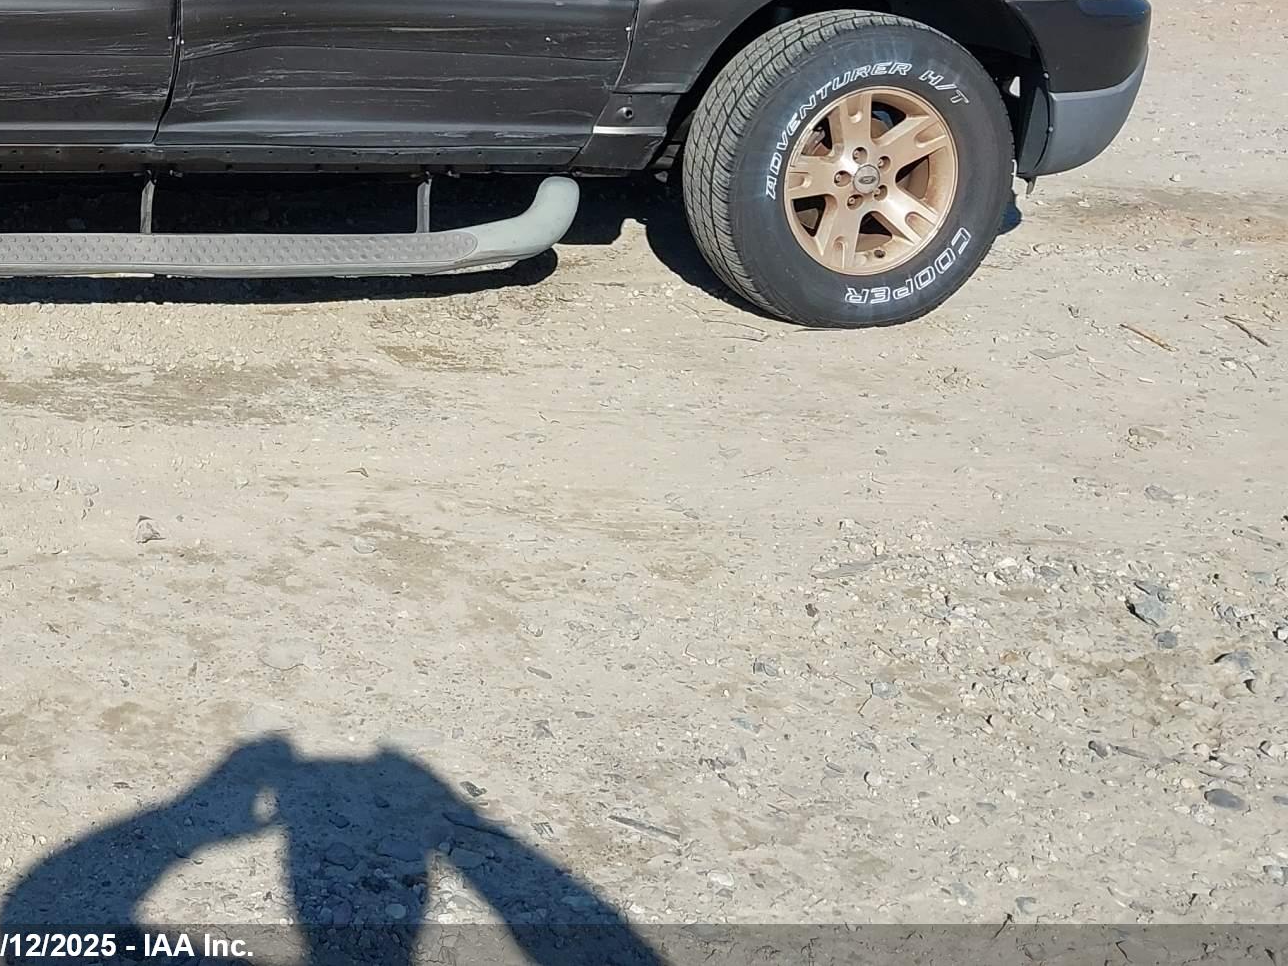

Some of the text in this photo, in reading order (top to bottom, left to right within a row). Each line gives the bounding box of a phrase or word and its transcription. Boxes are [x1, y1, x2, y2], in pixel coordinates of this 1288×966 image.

[765, 62, 970, 200] ADVENTURER H/T
[844, 227, 972, 304] COOPER
